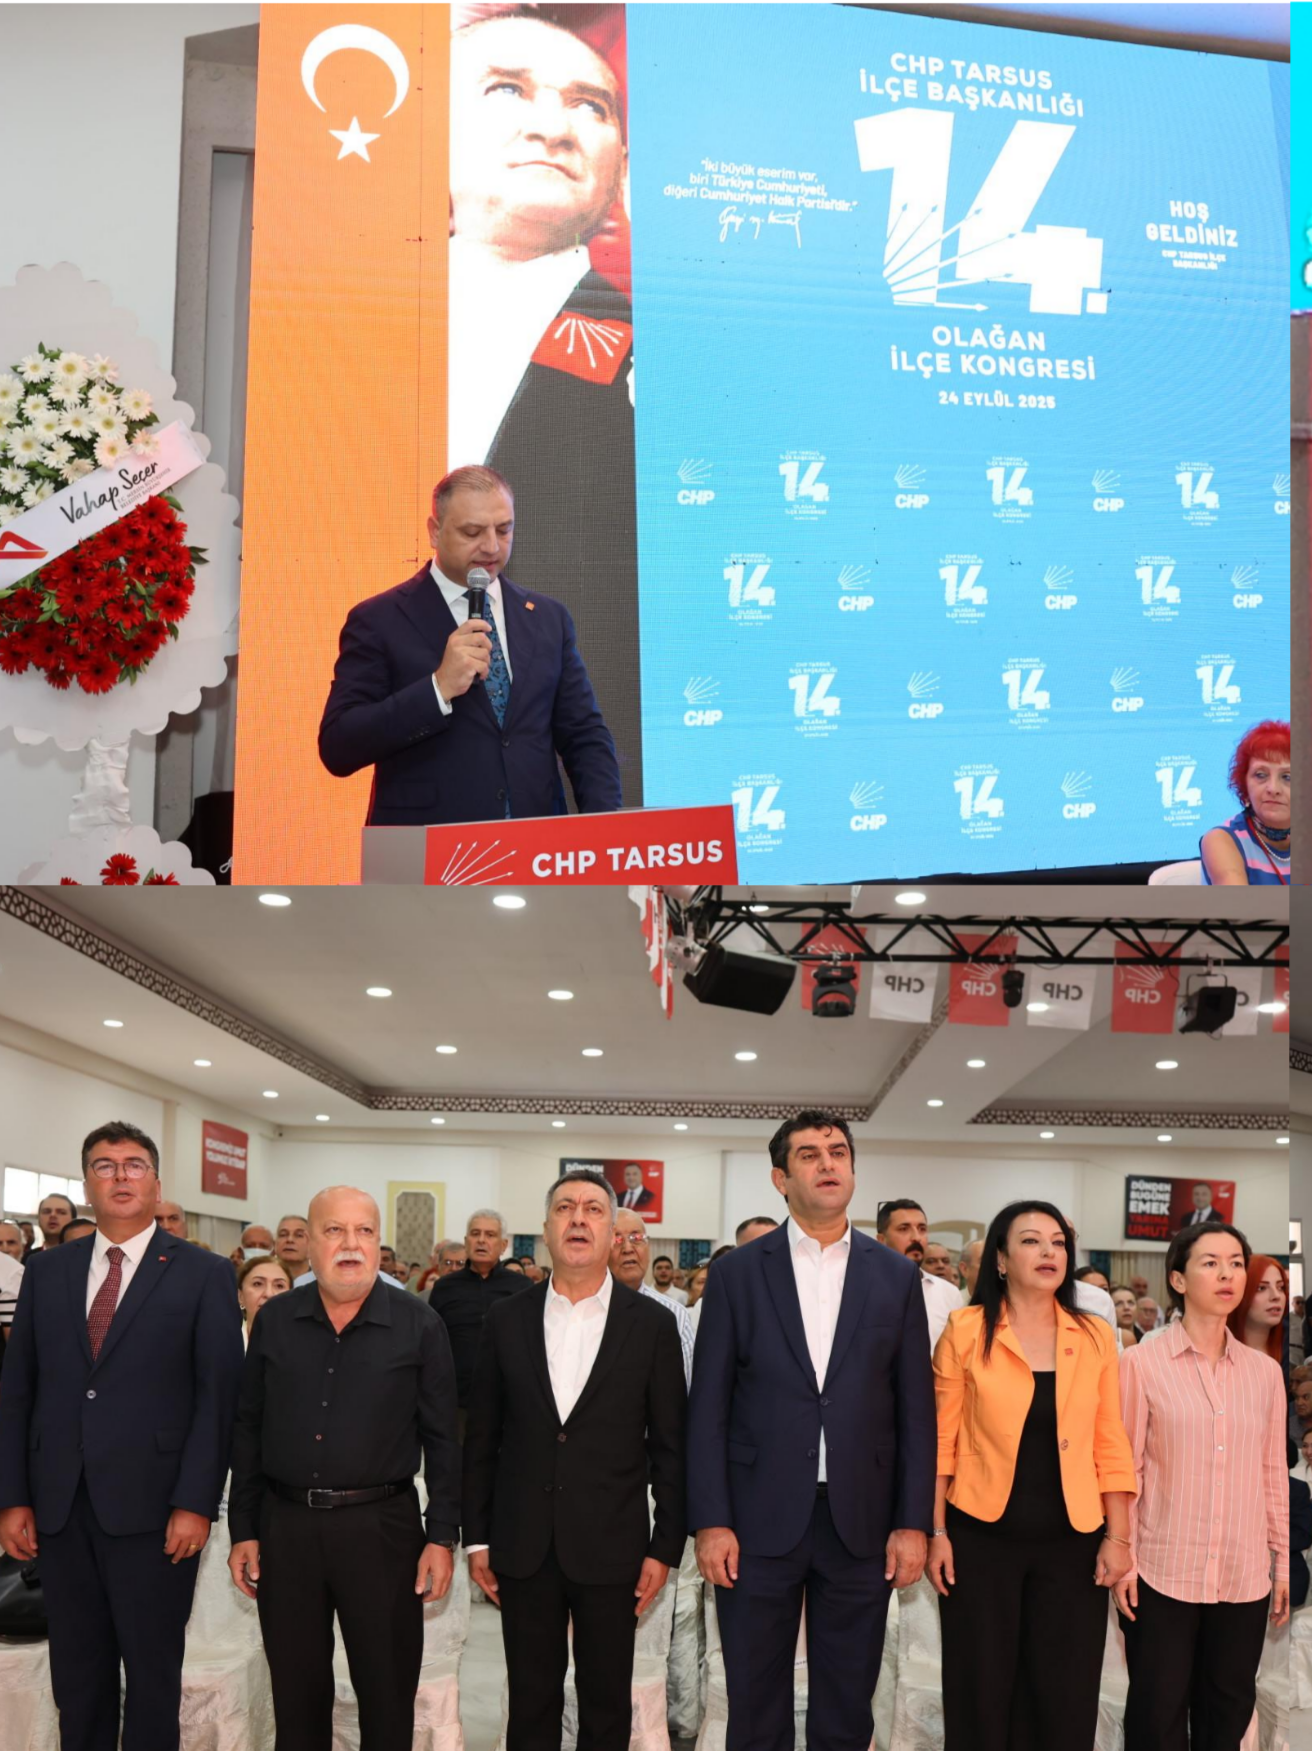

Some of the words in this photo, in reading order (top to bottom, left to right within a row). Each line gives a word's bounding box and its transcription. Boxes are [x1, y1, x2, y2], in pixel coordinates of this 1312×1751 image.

[890, 52, 944, 76] CHP
[951, 60, 1052, 89] TARSUS
[859, 68, 919, 102] İLÇE
[927, 81, 1084, 117] BAŞKANLIĞI
[721, 162, 755, 177] büyük
[757, 165, 796, 180] eserim
[689, 173, 709, 185] biri
[711, 174, 754, 190] Türkiye
[756, 179, 828, 197] Cumhuriyeti,
[663, 185, 698, 200] diğeri
[700, 187, 766, 206] Cumhuriyet
[769, 193, 795, 207] Halk
[1169, 200, 1210, 224] HOŞ
[1145, 222, 1239, 248] GELDİNİZ
[932, 324, 1046, 351] OLAĞAN
[890, 345, 951, 379] İLÇE
[961, 354, 1096, 380] KONGRESİ
[939, 390, 959, 405] 24
[963, 389, 1014, 408] EYLÜL
[1018, 394, 1056, 409] 2025
[59, 484, 120, 524] Vahap
[118, 462, 158, 491] Seçer
[678, 490, 714, 504] CHP
[896, 494, 929, 508] CHP
[1094, 498, 1124, 511] CHP
[839, 596, 874, 610] CHP
[1045, 596, 1077, 609] CHP
[1233, 594, 1262, 608] CHP
[909, 703, 943, 718] CHP
[1112, 698, 1143, 712] CHP
[684, 710, 722, 725] CHP
[1063, 803, 1096, 818] CHP
[851, 815, 886, 830] CHP
[532, 850, 596, 877] CHP
[607, 839, 723, 871] TARSUS
[1131, 1179, 1172, 1191] DÜNDEN
[1130, 1190, 1171, 1202] BUGÜNE
[1129, 1200, 1170, 1215] EMEK
